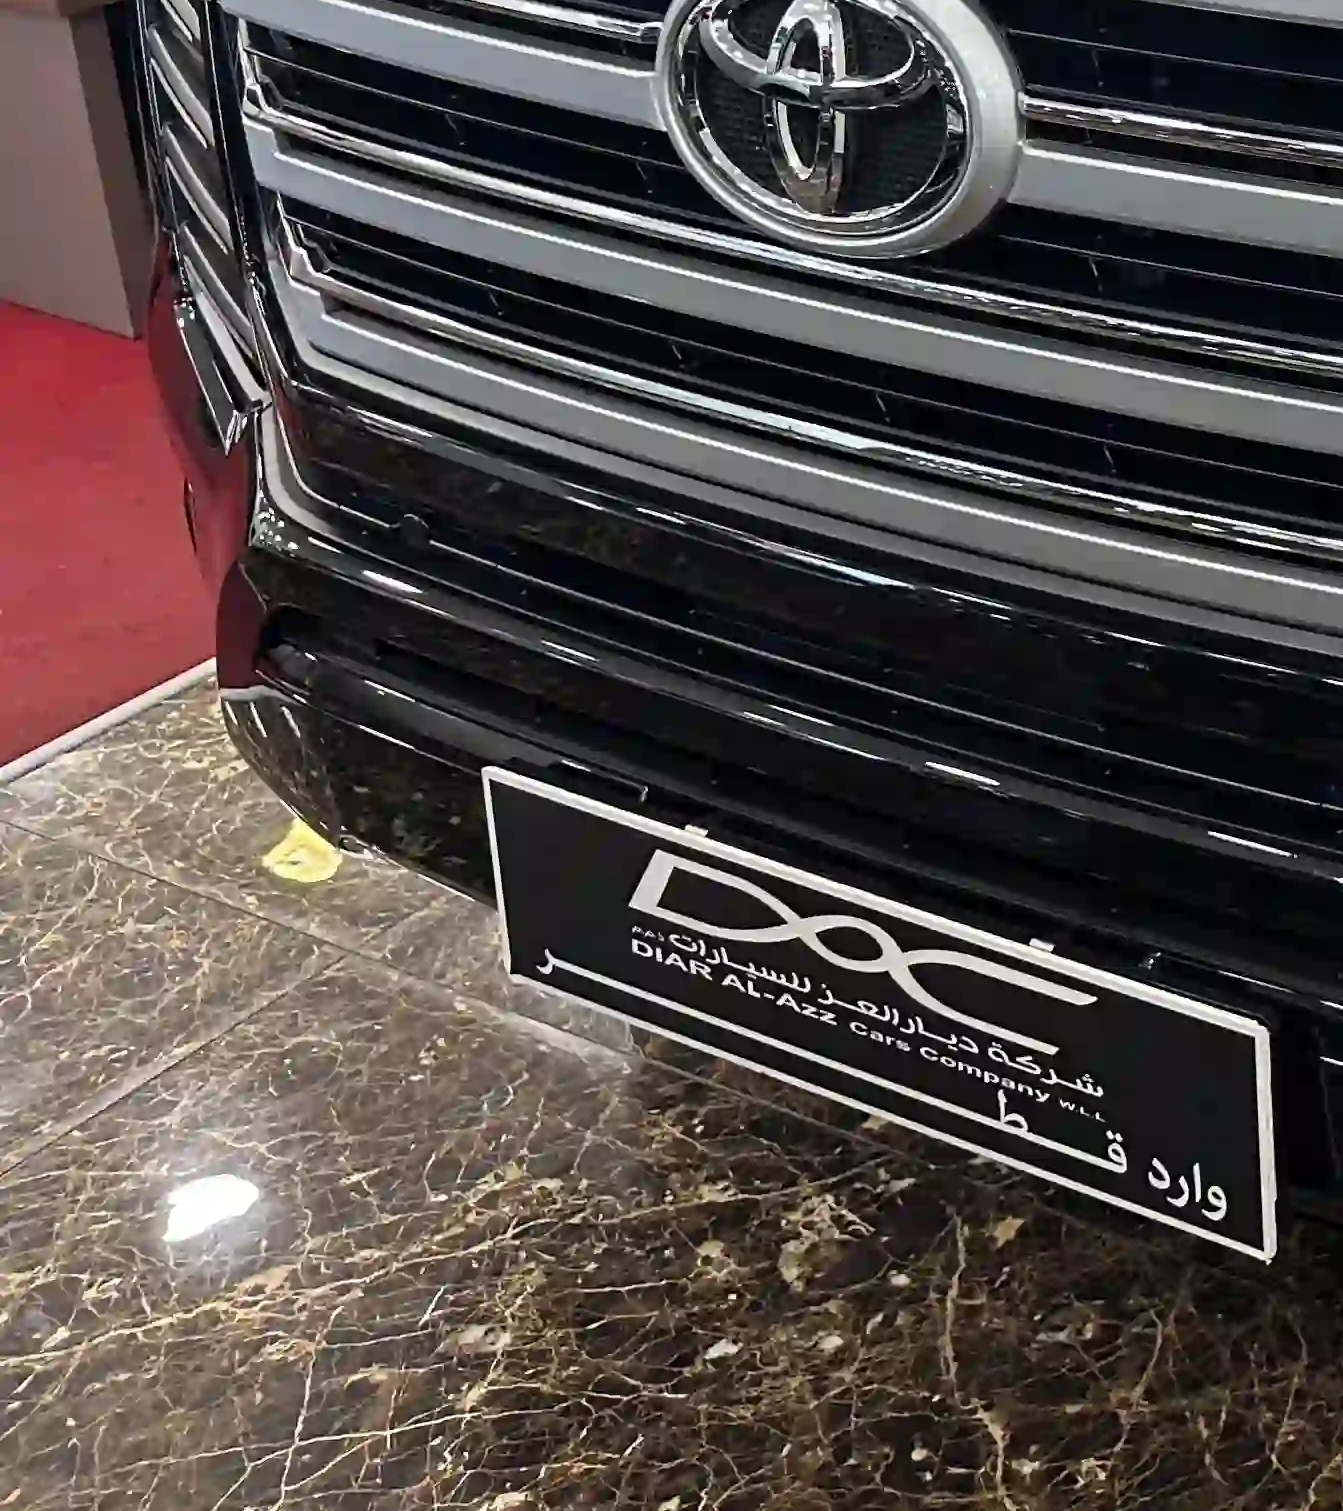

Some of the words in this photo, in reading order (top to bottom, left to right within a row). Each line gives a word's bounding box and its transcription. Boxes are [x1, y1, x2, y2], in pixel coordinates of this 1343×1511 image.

[668, 933, 812, 993] للسيارات
[632, 938, 713, 981] DIAR
[850, 1021, 912, 1052] Cars
[919, 1047, 1050, 1102] Company
[899, 1016, 980, 1054] ديار
[988, 1042, 1104, 1097] شركة
[1147, 1155, 1229, 1221] وارد
